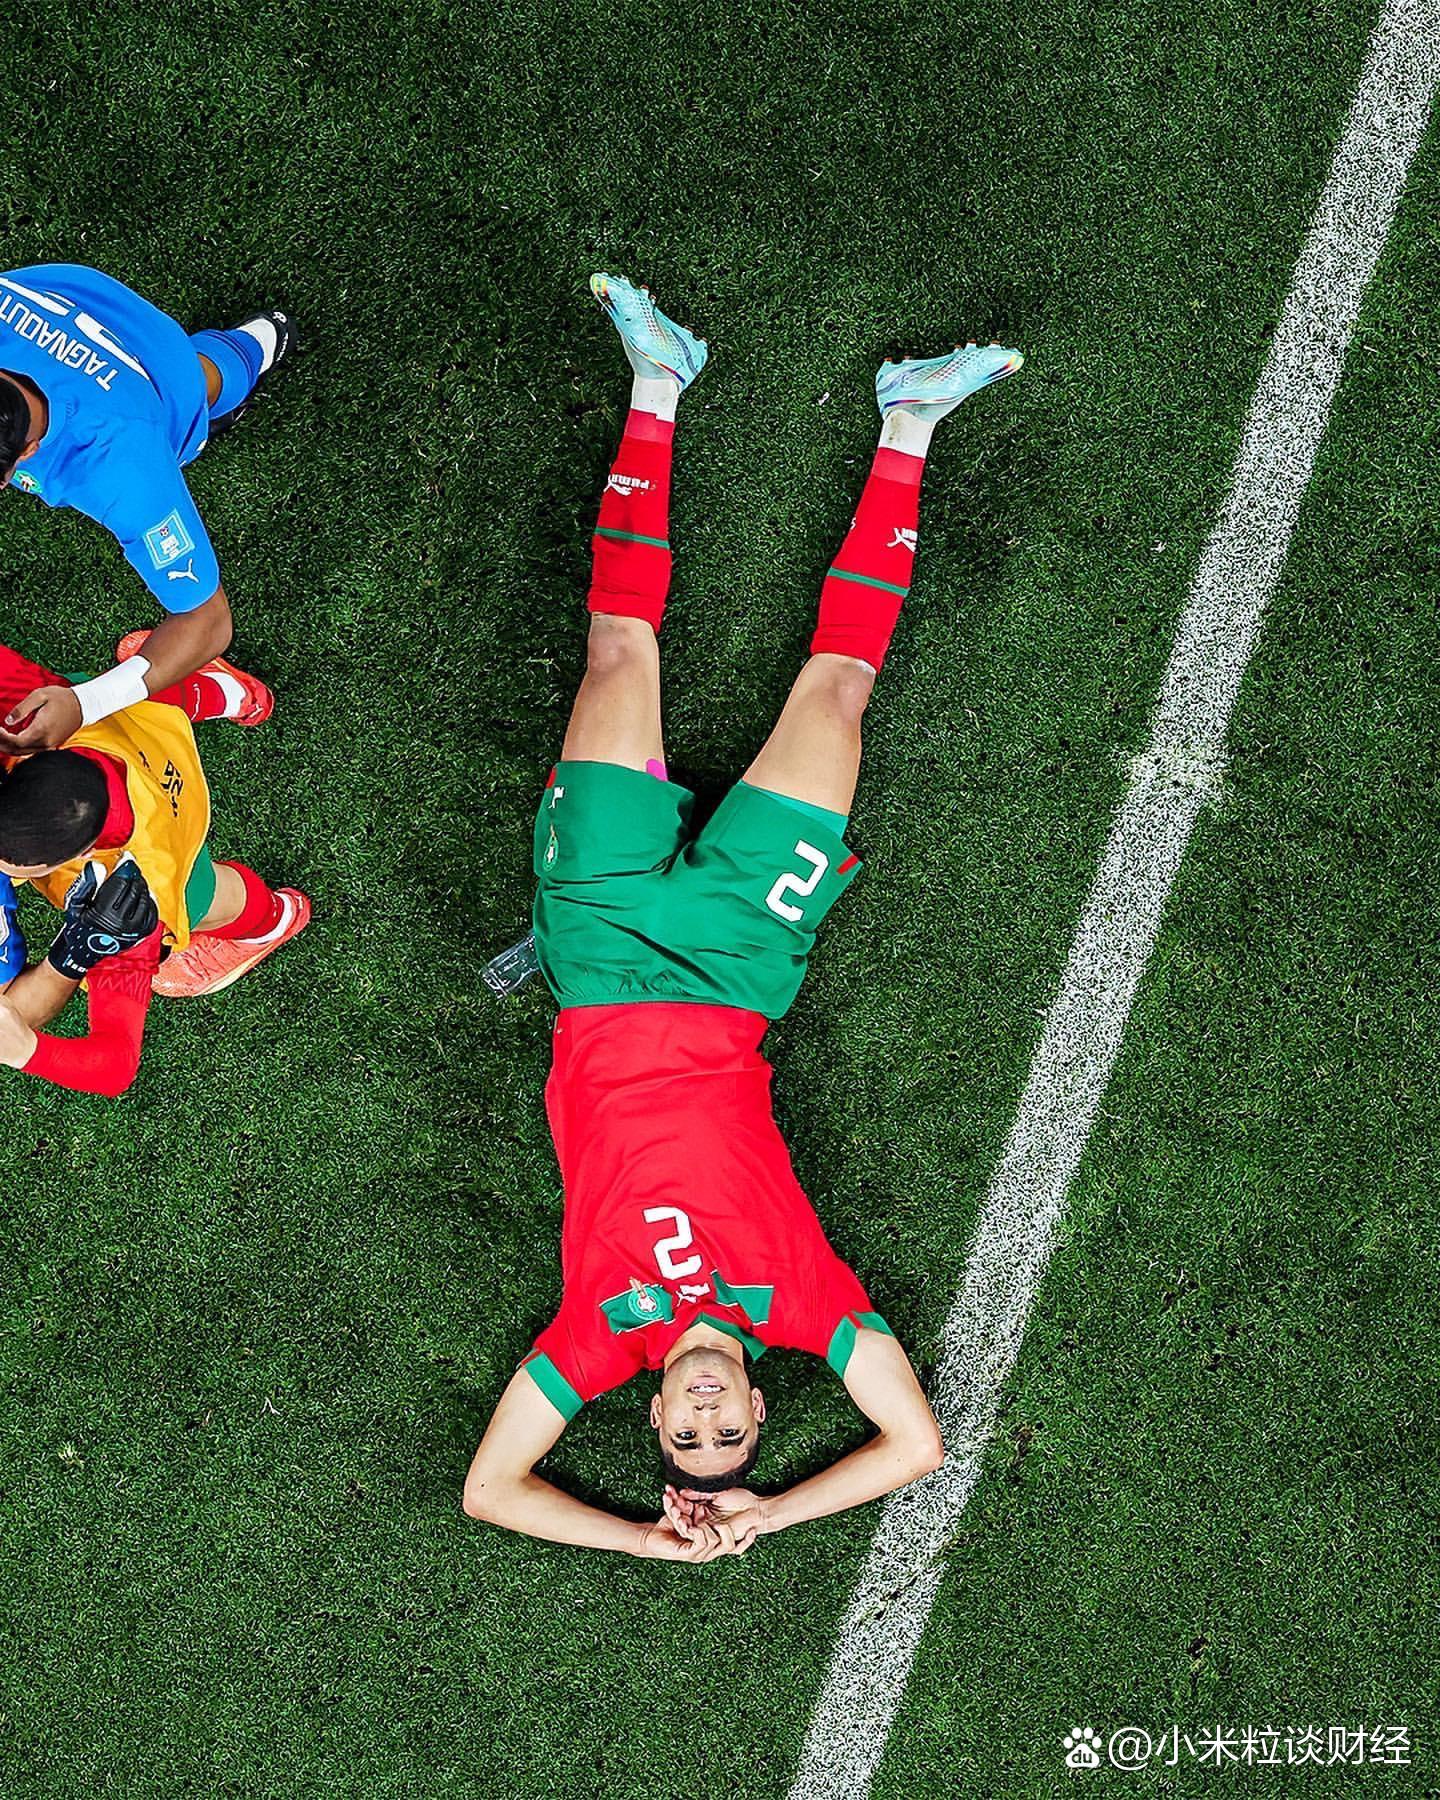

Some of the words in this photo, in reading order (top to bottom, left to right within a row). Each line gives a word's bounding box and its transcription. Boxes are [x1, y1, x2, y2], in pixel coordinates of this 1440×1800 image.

[0, 291, 118, 391] TAGNAOUT
[765, 839, 829, 922] 2
[643, 1206, 702, 1280] 2
